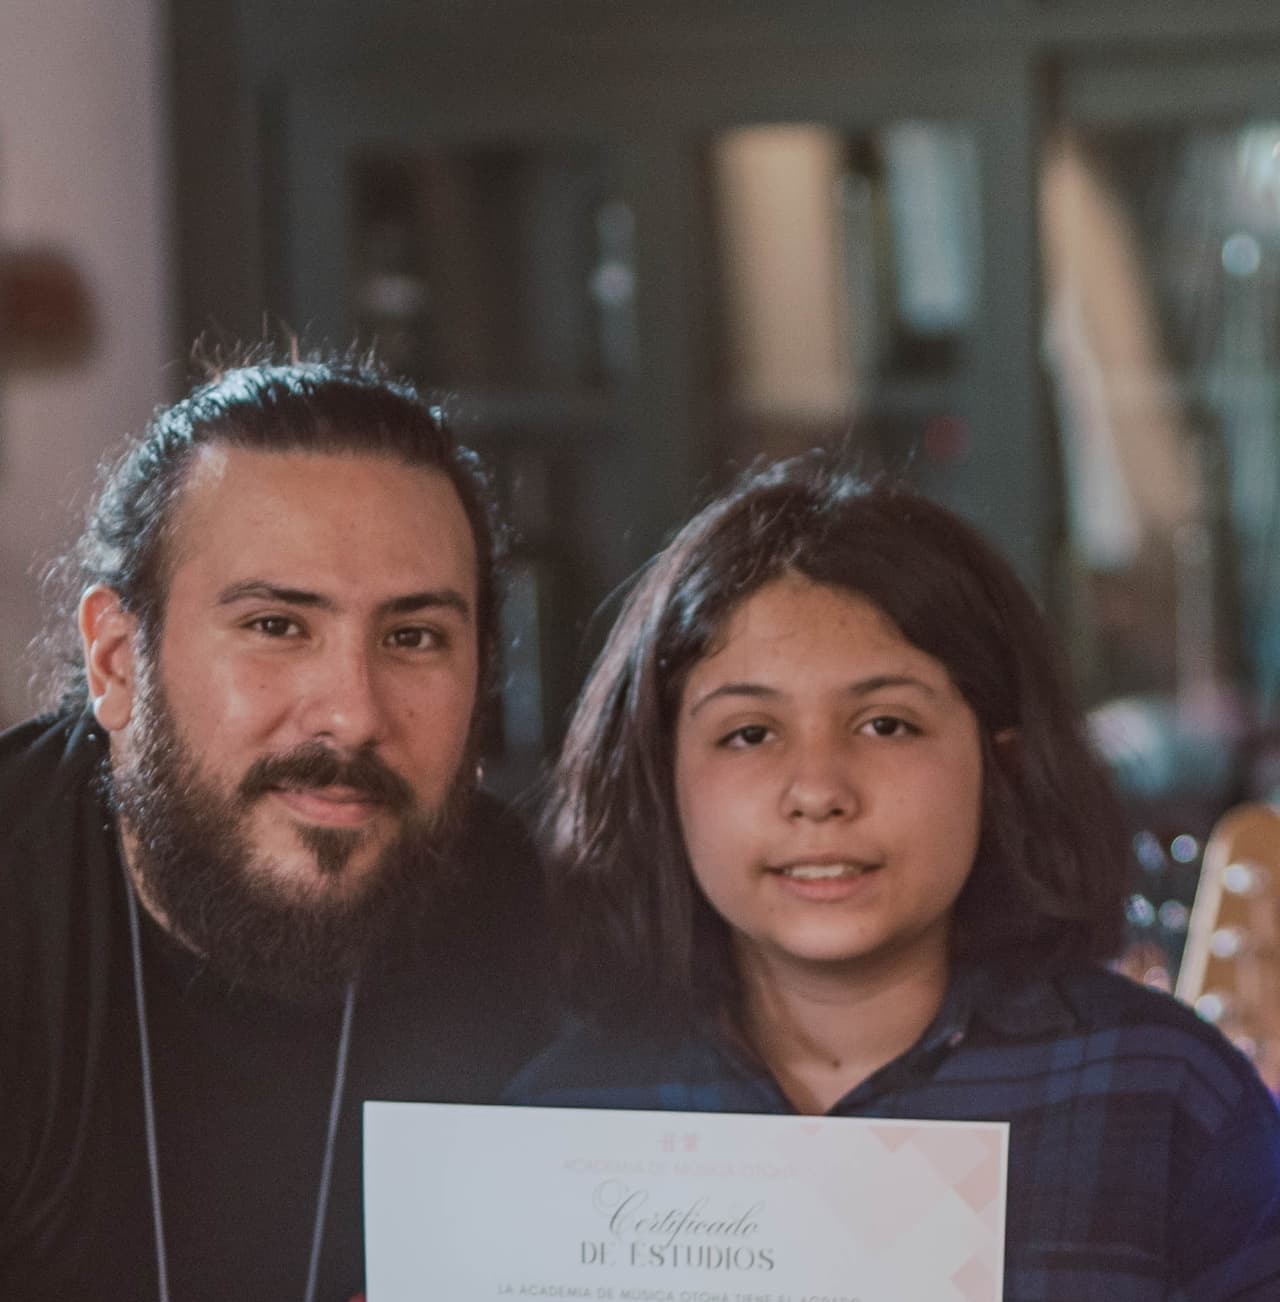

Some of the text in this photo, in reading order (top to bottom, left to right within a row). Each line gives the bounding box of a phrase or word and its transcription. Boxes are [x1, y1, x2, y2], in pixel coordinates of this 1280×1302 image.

[592, 1177, 766, 1249] Certificado
[581, 1241, 775, 1272] DE ESTUDIOS
[497, 1284, 513, 1296] LA
[519, 1285, 592, 1299] ACADEMIA
[597, 1288, 614, 1300] DE
